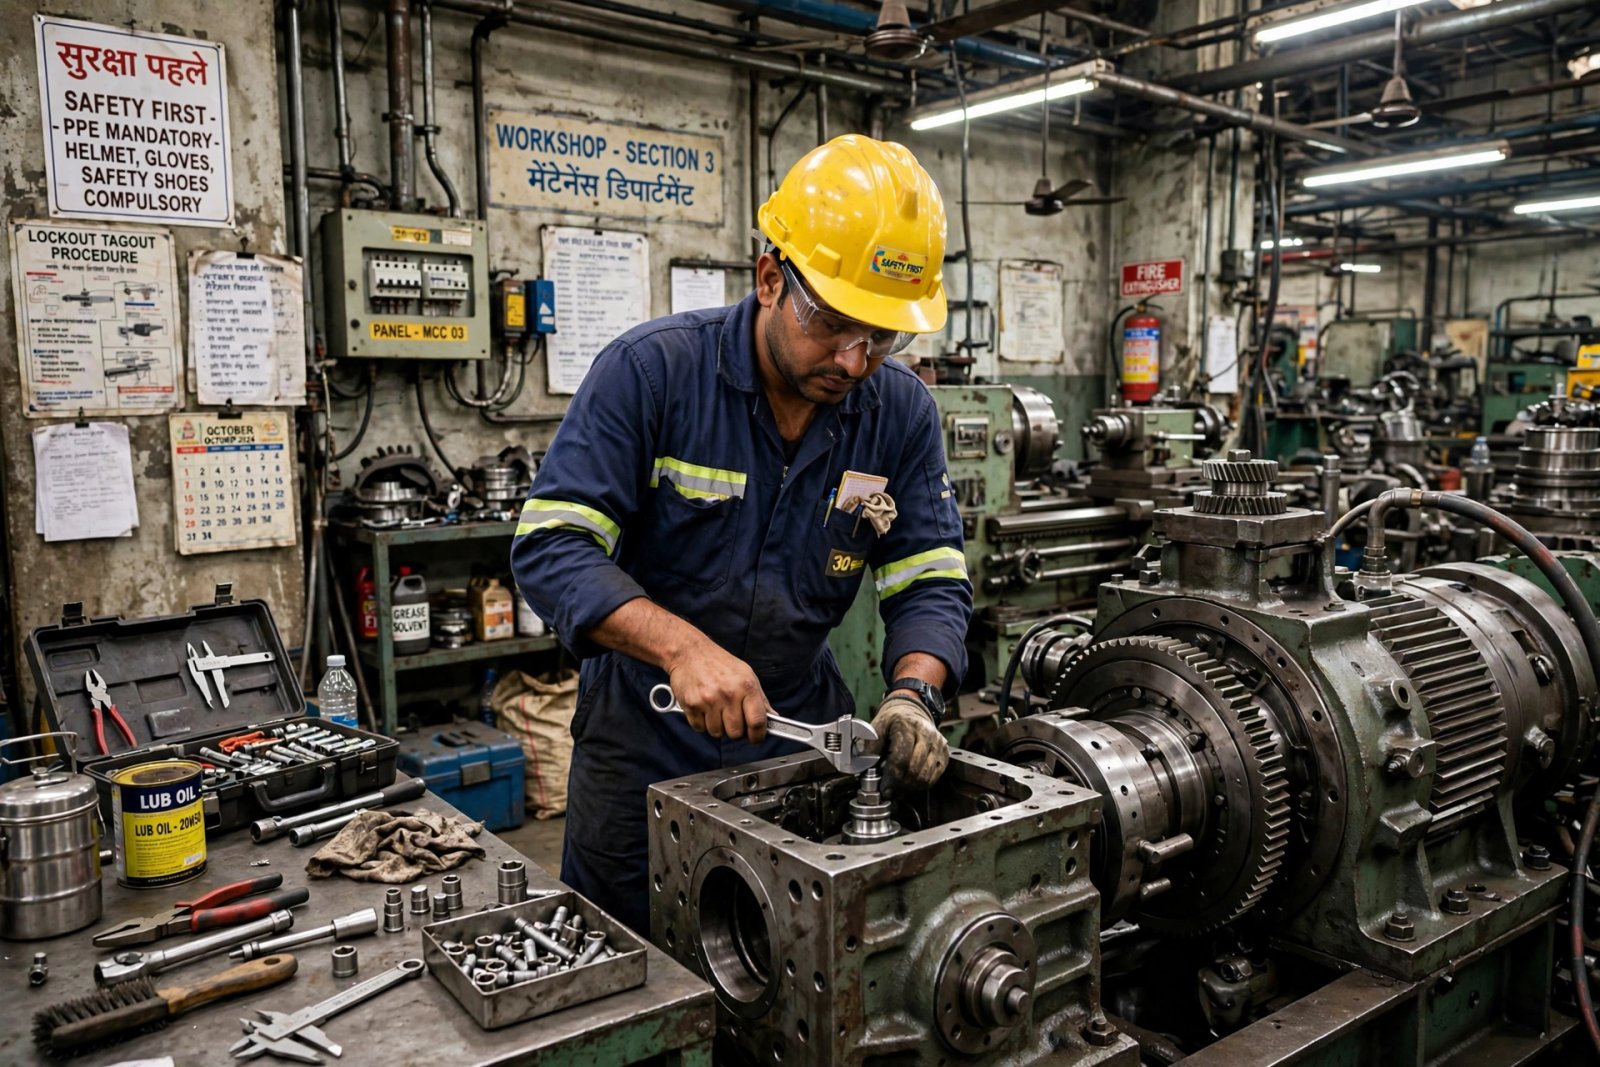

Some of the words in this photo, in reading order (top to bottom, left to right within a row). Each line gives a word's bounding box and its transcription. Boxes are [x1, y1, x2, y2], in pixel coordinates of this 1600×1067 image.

[56, 42, 137, 80] सुरक्षा
[145, 51, 208, 86] पहले
[64, 90, 144, 118] SAFETY
[64, 118, 99, 138] PPE
[65, 142, 140, 167] HELMET,
[145, 151, 214, 174] GLOVES,
[496, 123, 607, 159] WORKSHOP
[626, 140, 699, 171] SECTION
[704, 151, 714, 173] 3
[82, 166, 148, 187] SAFETY
[154, 172, 209, 192] SHOES
[527, 160, 599, 197] मेंटेनेंस
[606, 167, 694, 206] डिपार्टमेंट
[84, 189, 202, 213] COMPULSORY
[28, 229, 97, 246] LOCKOUT
[101, 233, 156, 249] TAGOUT
[51, 247, 138, 263] PROCEDURE
[1137, 264, 1166, 279] FIRE
[373, 325, 412, 338] PANEL
[423, 326, 447, 338] MCC
[451, 327, 464, 339] 03
[207, 425, 253, 435] OCTOBER
[833, 555, 851, 571] 30
[393, 606, 426, 620] GREASE
[393, 620, 427, 632] SOLVENT
[140, 792, 172, 809] LUB
[176, 786, 196, 804] OIL
[135, 824, 154, 837] LUB
[156, 822, 172, 835] OIL
